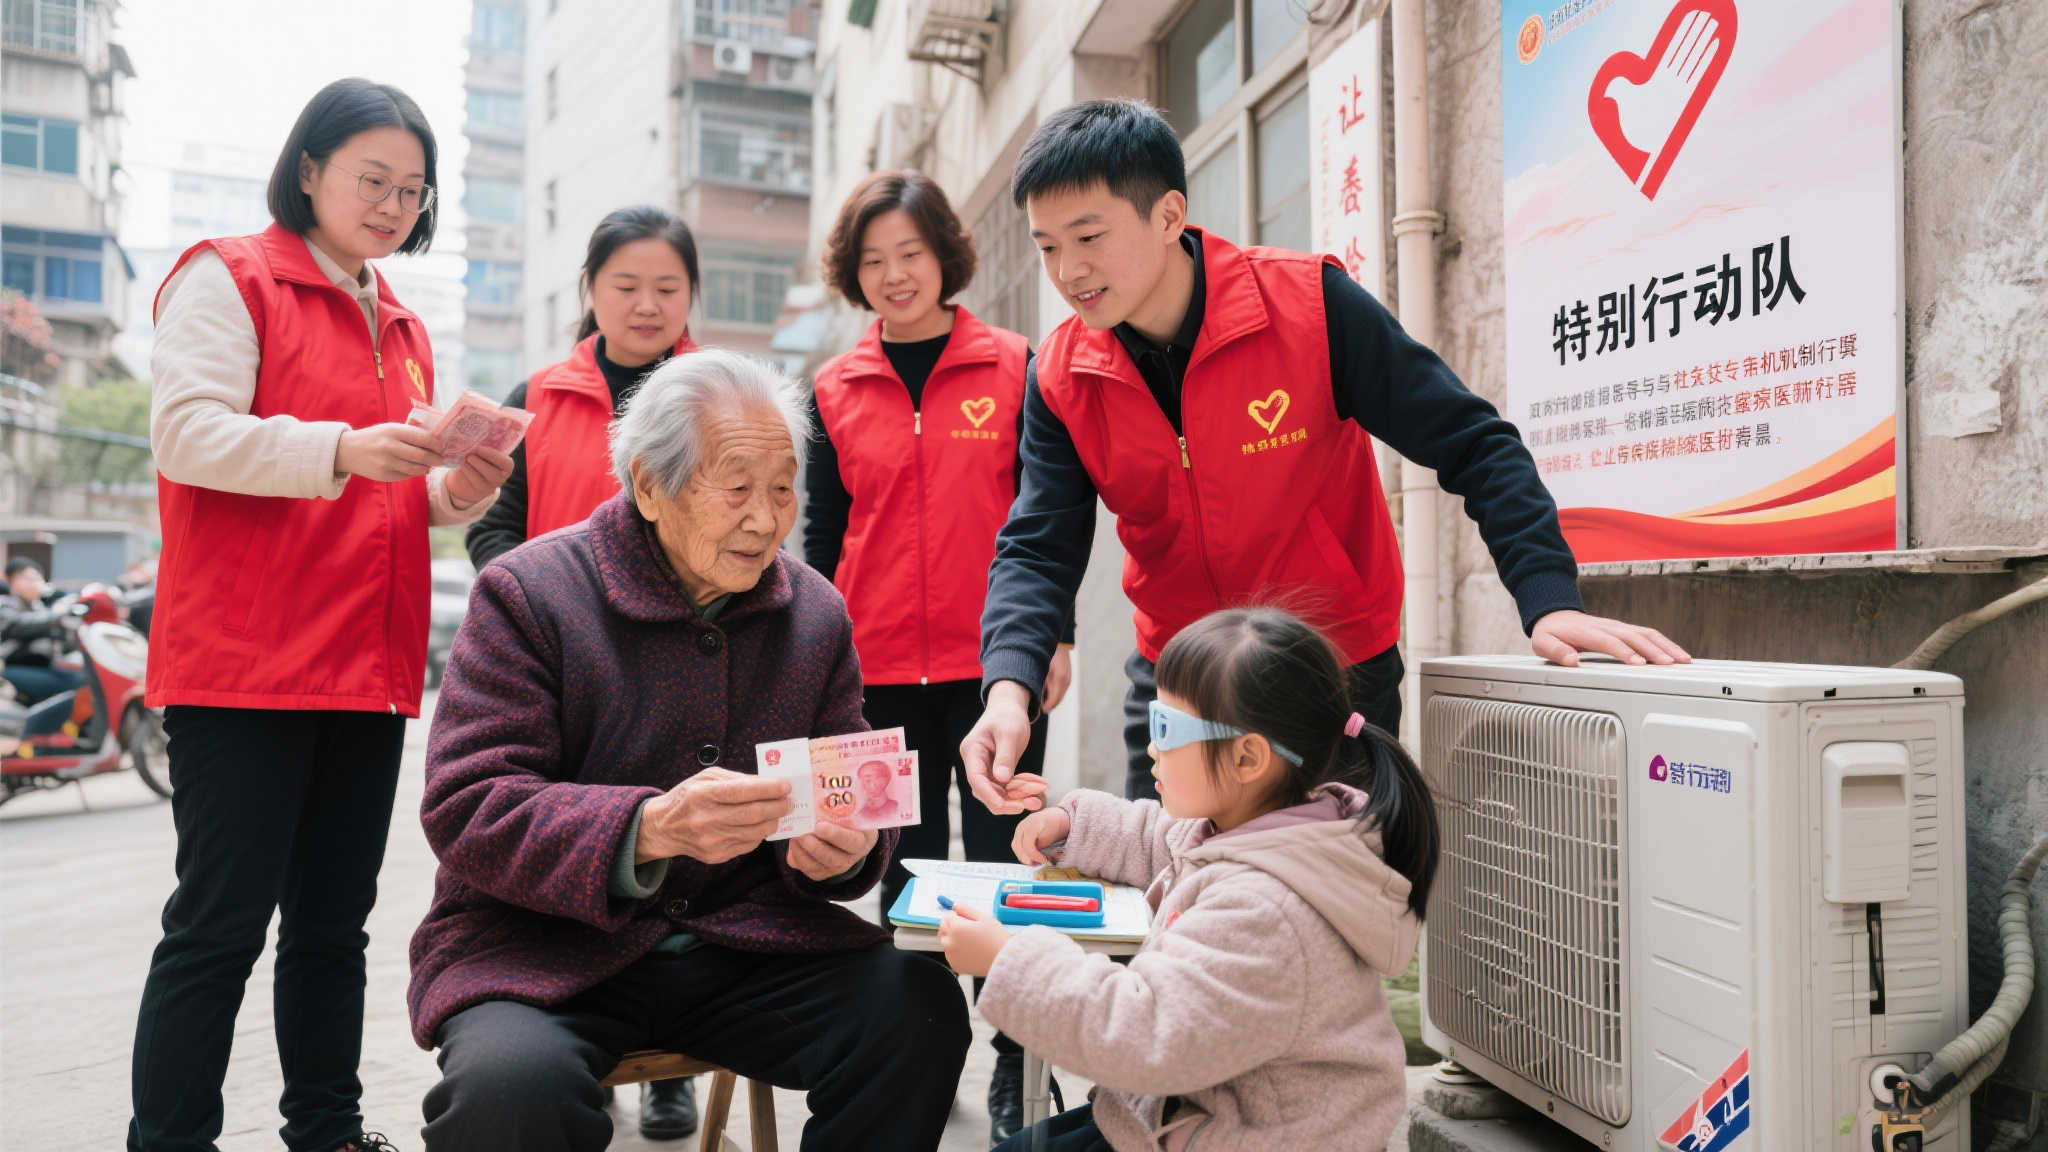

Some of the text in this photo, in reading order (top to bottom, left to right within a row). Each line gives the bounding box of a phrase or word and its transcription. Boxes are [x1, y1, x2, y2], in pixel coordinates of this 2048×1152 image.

[1553, 235, 1807, 366] 特别行动队
